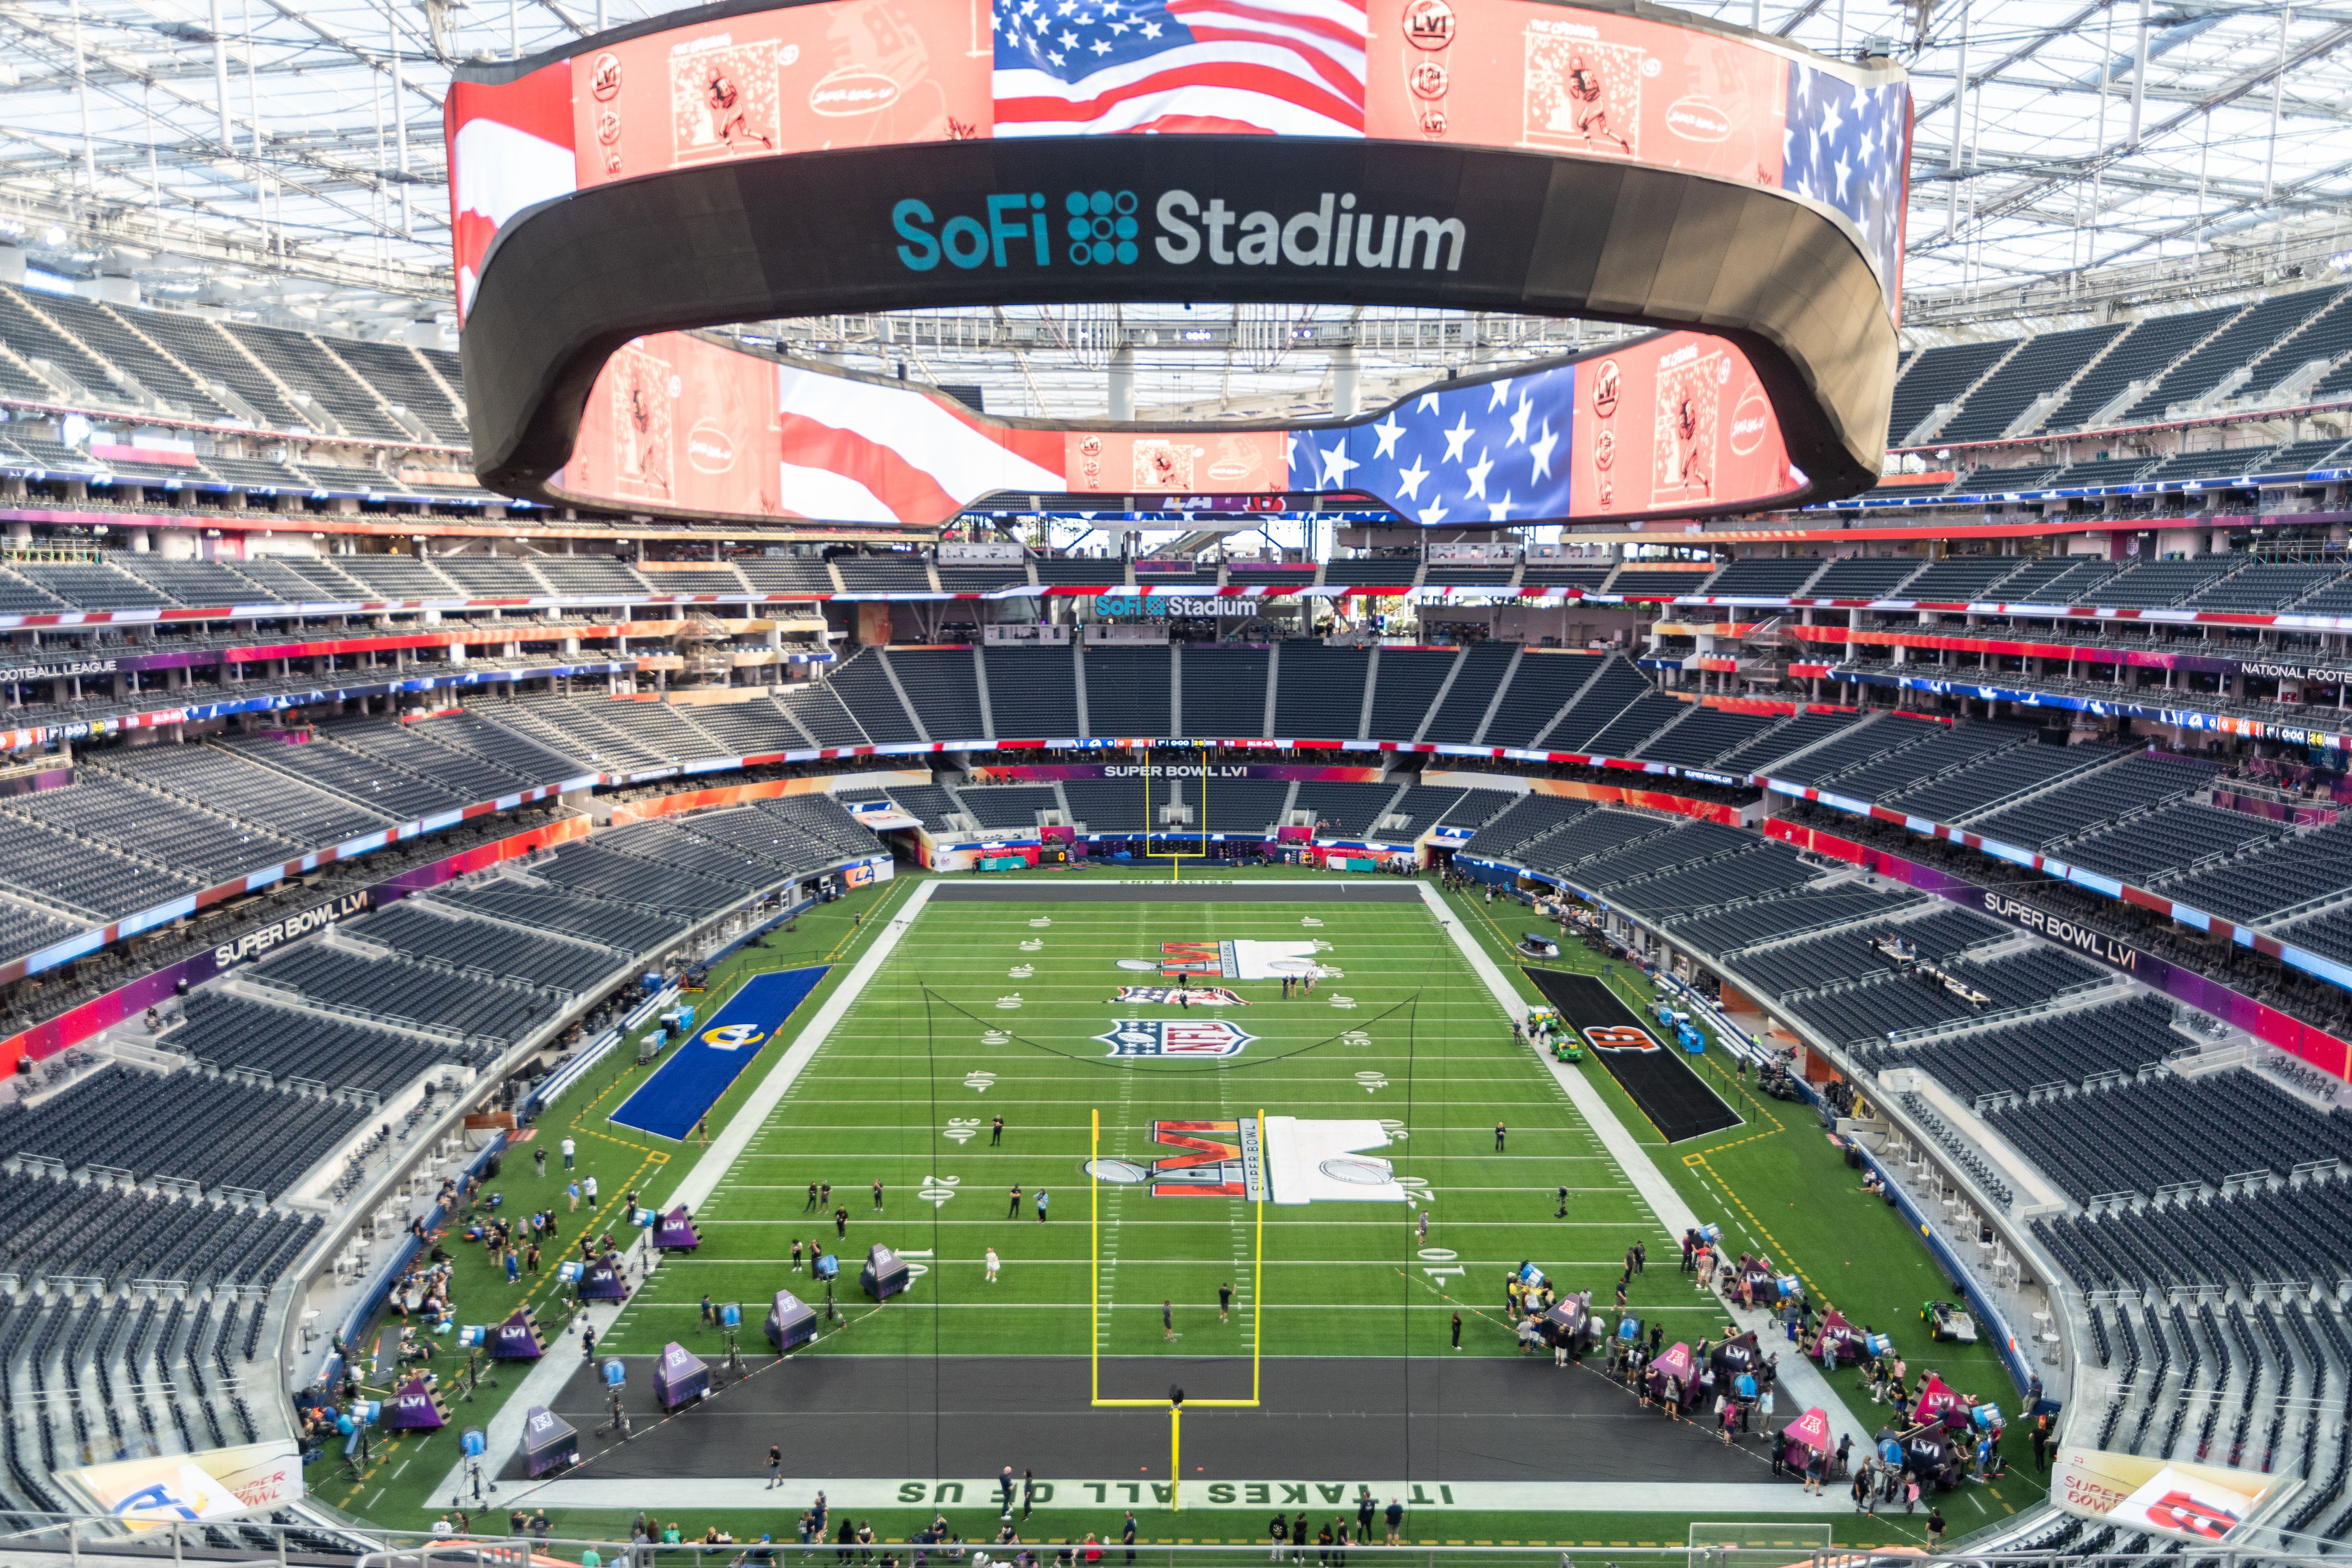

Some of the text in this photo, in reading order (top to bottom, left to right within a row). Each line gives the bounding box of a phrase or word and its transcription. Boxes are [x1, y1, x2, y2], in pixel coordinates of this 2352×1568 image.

[1413, 16, 1446, 32] LVI
[892, 190, 1466, 272] SoFi Stadium
[1598, 378, 1616, 399] LVI
[1096, 596, 1257, 616] SoFi Stadium
[0, 660, 117, 681] OOTBALL LEAGUE
[2241, 662, 2352, 684] NATIONAL FOOTB
[66, 724, 88, 735] 0:00
[93, 721, 105, 731] 25
[2282, 730, 2304, 741] 0:00
[2310, 733, 2323, 743] 25
[1105, 766, 1248, 777] SUPER BOWL LVI
[1705, 773, 1722, 782] BOWL
[1058, 851, 1065, 861] 0
[215, 890, 368, 966] SUPER BOWL LVI
[1029, 918, 1051, 927] 10
[1301, 918, 1324, 927] 10
[1984, 892, 2135, 969] SUPER BOWL LVI
[1224, 944, 1234, 974] SUPER BOWL
[1008, 966, 1035, 977] 30
[995, 996, 1024, 1008] 40
[1328, 997, 1357, 1009] 40
[1167, 1023, 1234, 1052] NFL
[964, 1071, 997, 1086] 40
[1355, 1071, 1388, 1088] 40
[943, 1118, 981, 1138] 30
[1247, 1124, 1265, 1192] SUPER BOWL
[918, 1175, 960, 1201] 20
[663, 1219, 684, 1231] LVI
[1418, 1248, 1466, 1276] 10
[501, 1325, 526, 1339] LVI
[1726, 1346, 1750, 1361] LVI
[399, 1394, 426, 1408] LVI
[1929, 1393, 1953, 1406] LVI
[1912, 1440, 1939, 1457] LVI
[235, 1470, 286, 1499] UPER
[897, 1482, 964, 1503] US
[1083, 1482, 1180, 1503] ALL
[242, 1486, 283, 1506] OWL
[1208, 1483, 1379, 1504] TAKES
[1408, 1483, 1454, 1505] IT
[2068, 1491, 2116, 1513] BOW
